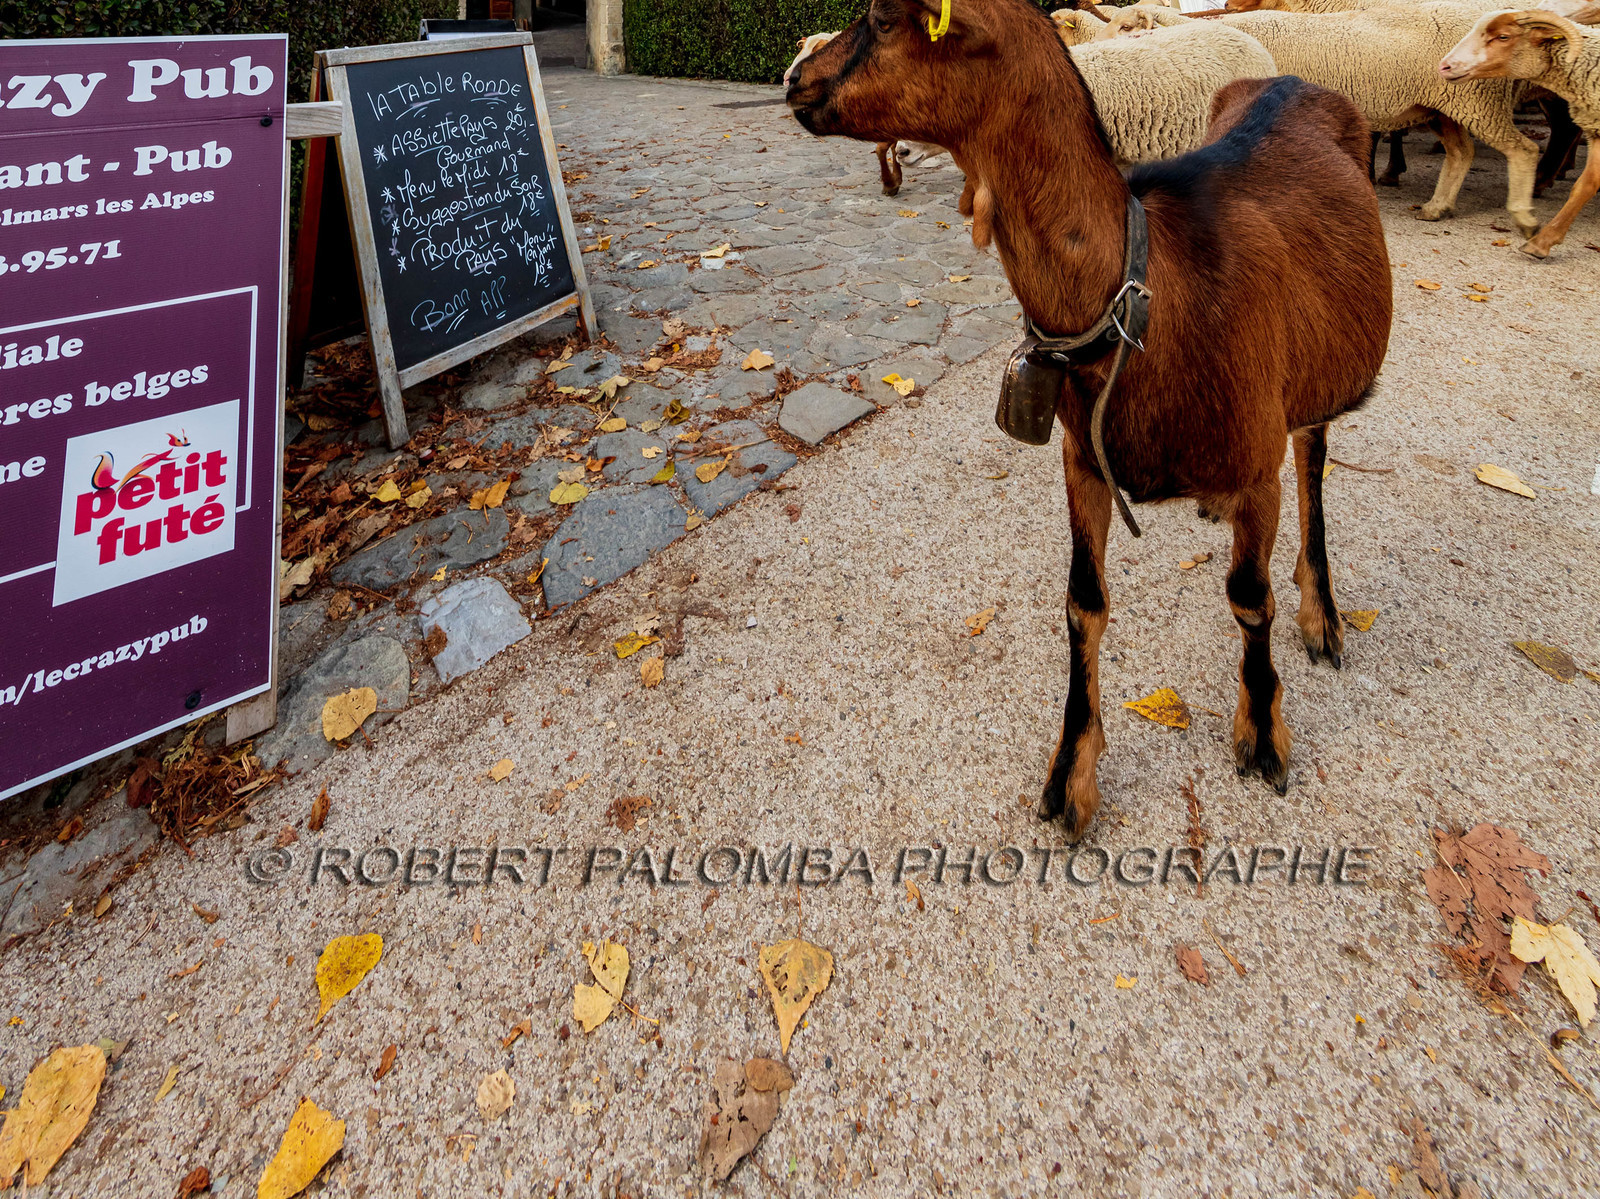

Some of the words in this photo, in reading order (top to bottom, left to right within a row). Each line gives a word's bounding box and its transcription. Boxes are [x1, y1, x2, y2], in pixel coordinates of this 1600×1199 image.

[0, 72, 107, 117] zy
[127, 56, 275, 103] Pub
[0, 154, 91, 190] ant
[133, 140, 233, 176] Pub
[0, 202, 89, 227] lmars
[95, 197, 134, 216] les
[140, 190, 215, 211] Alpes
[0, 335, 84, 371] iale
[0, 392, 73, 426] res
[84, 364, 209, 408] belges
[74, 448, 228, 536] petit
[96, 492, 226, 566] futé
